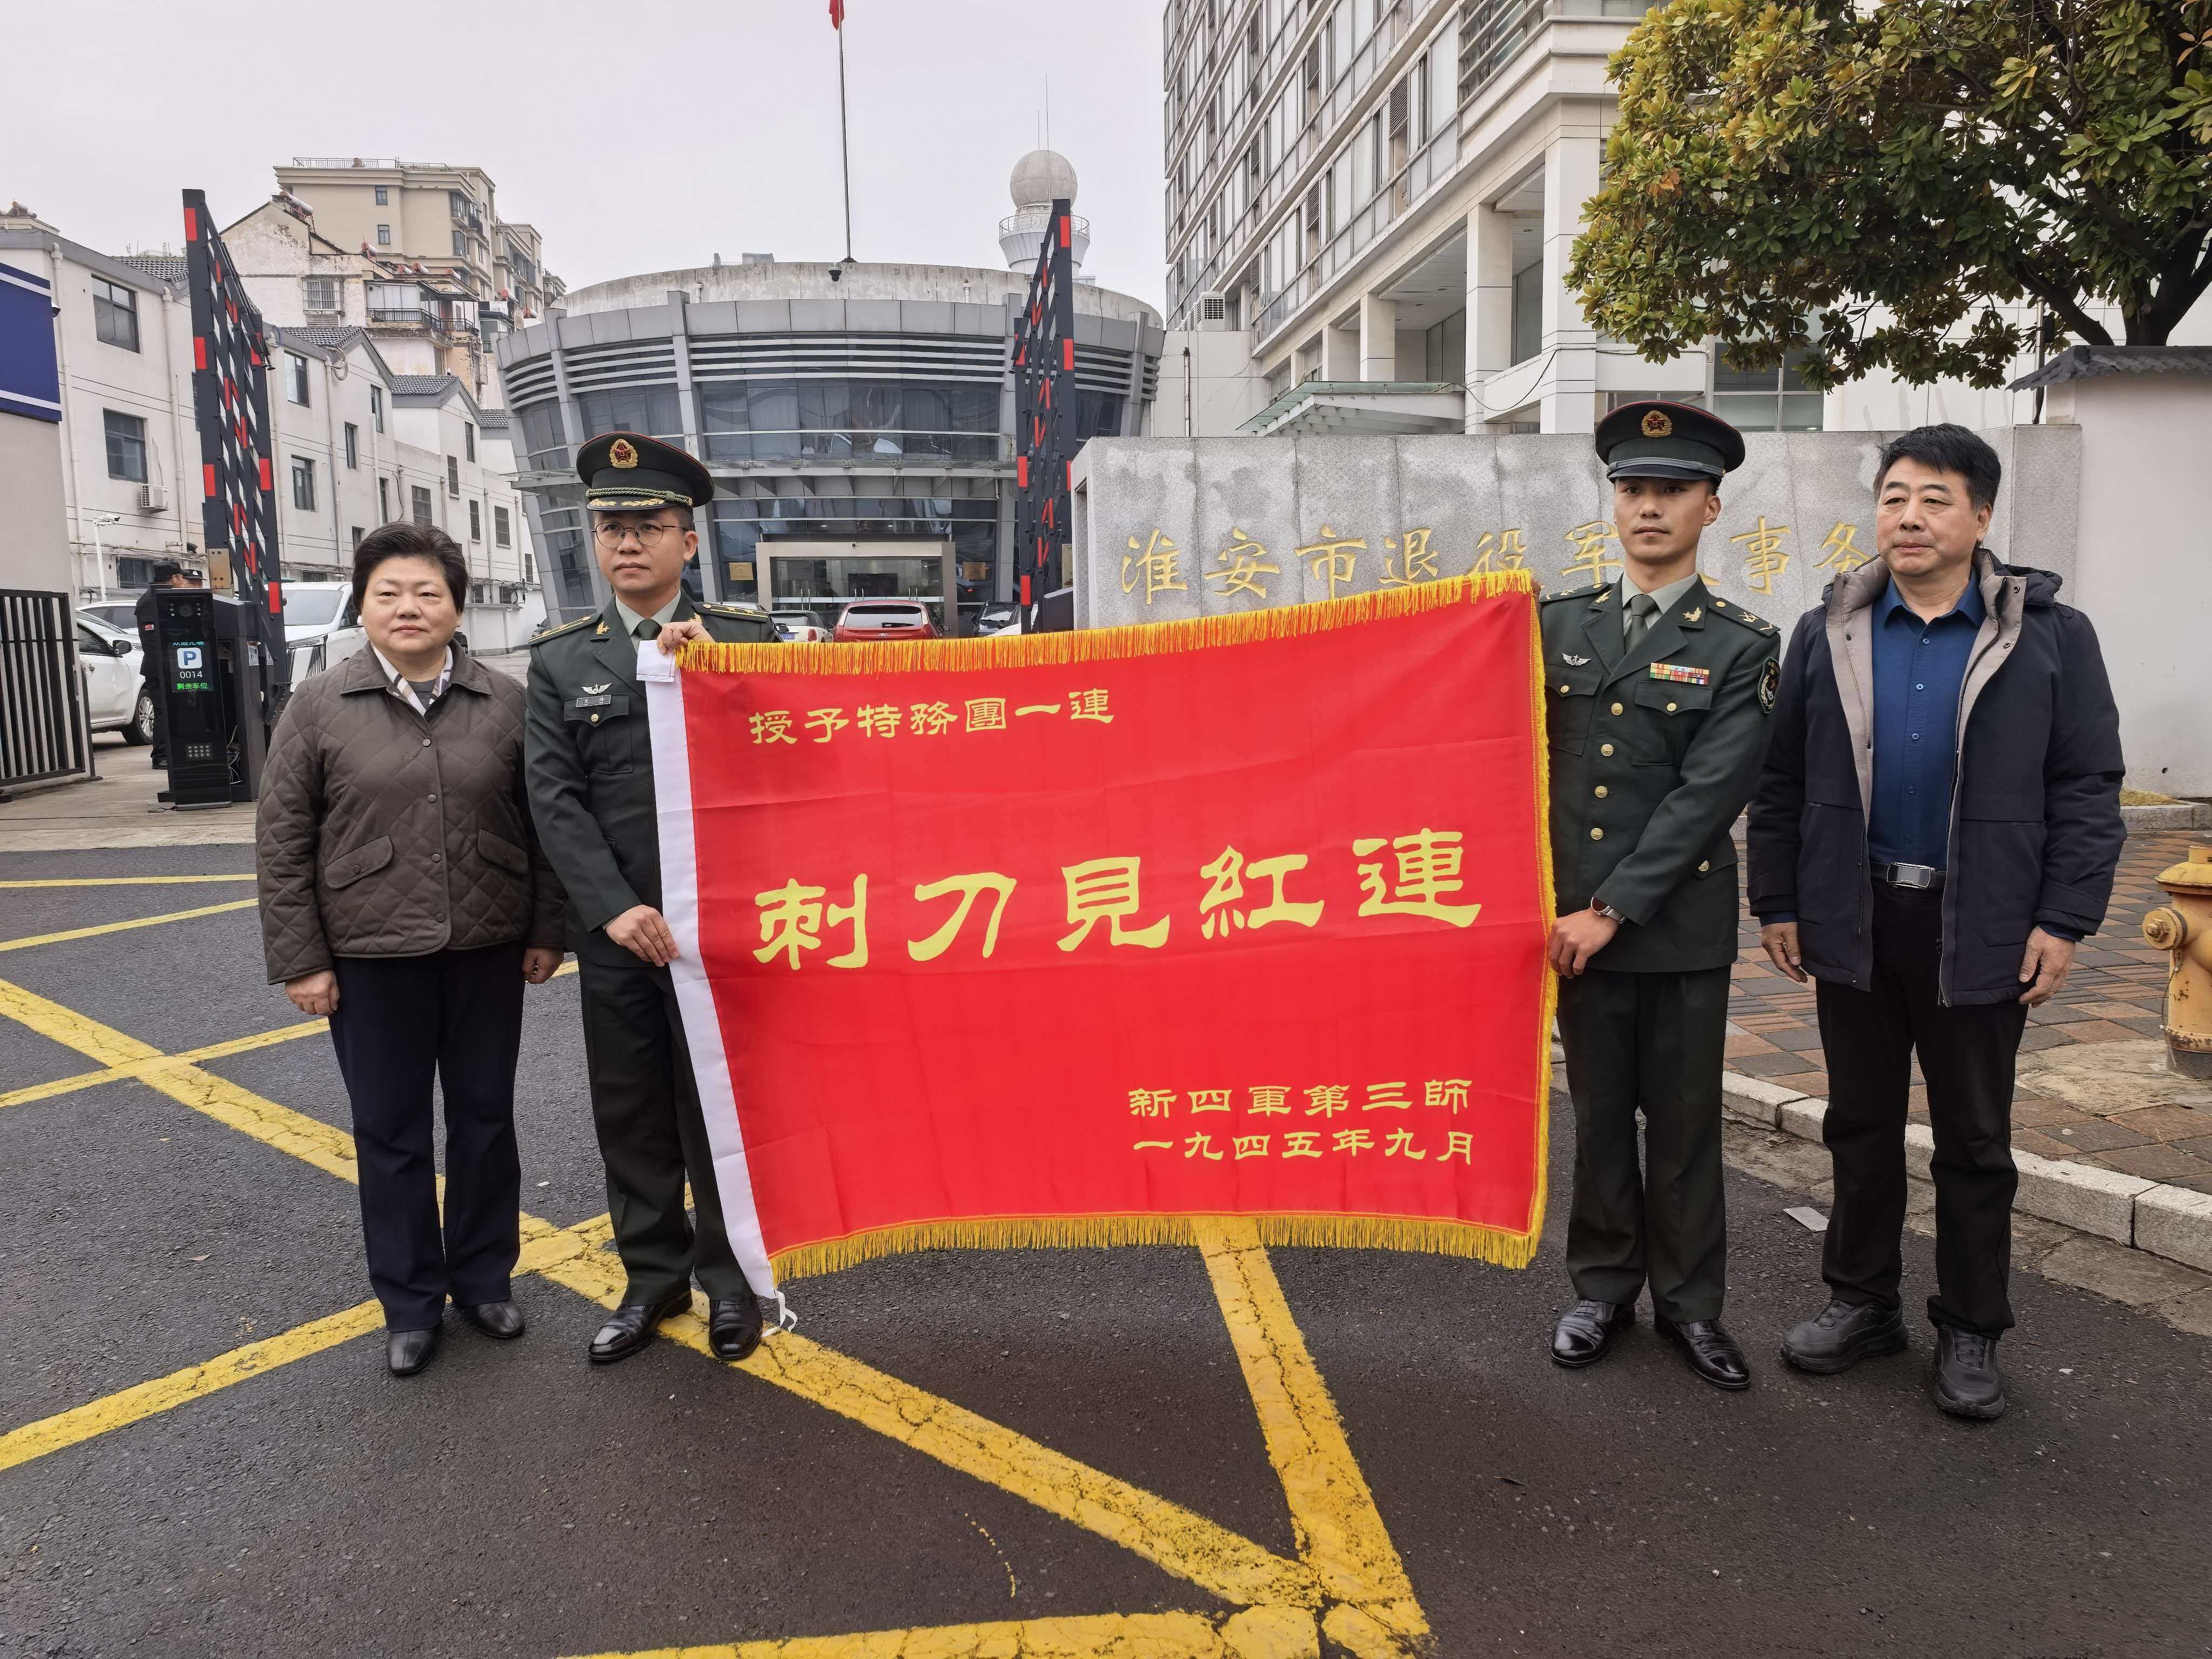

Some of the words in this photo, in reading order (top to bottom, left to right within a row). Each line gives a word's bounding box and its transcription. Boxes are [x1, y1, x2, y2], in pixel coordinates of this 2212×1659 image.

[1121, 516, 1872, 605] 淮安市退役军事务
[180, 671, 203, 679] 0014
[183, 651, 197, 666] P
[177, 682, 208, 690] 剩余车位
[748, 688, 1115, 744] 授予特務團一連
[753, 827, 1482, 970] 刺刀見紅連
[1128, 1079, 1473, 1118] 新四軍第三師
[1133, 1128, 1473, 1165] 一九四五年九月
